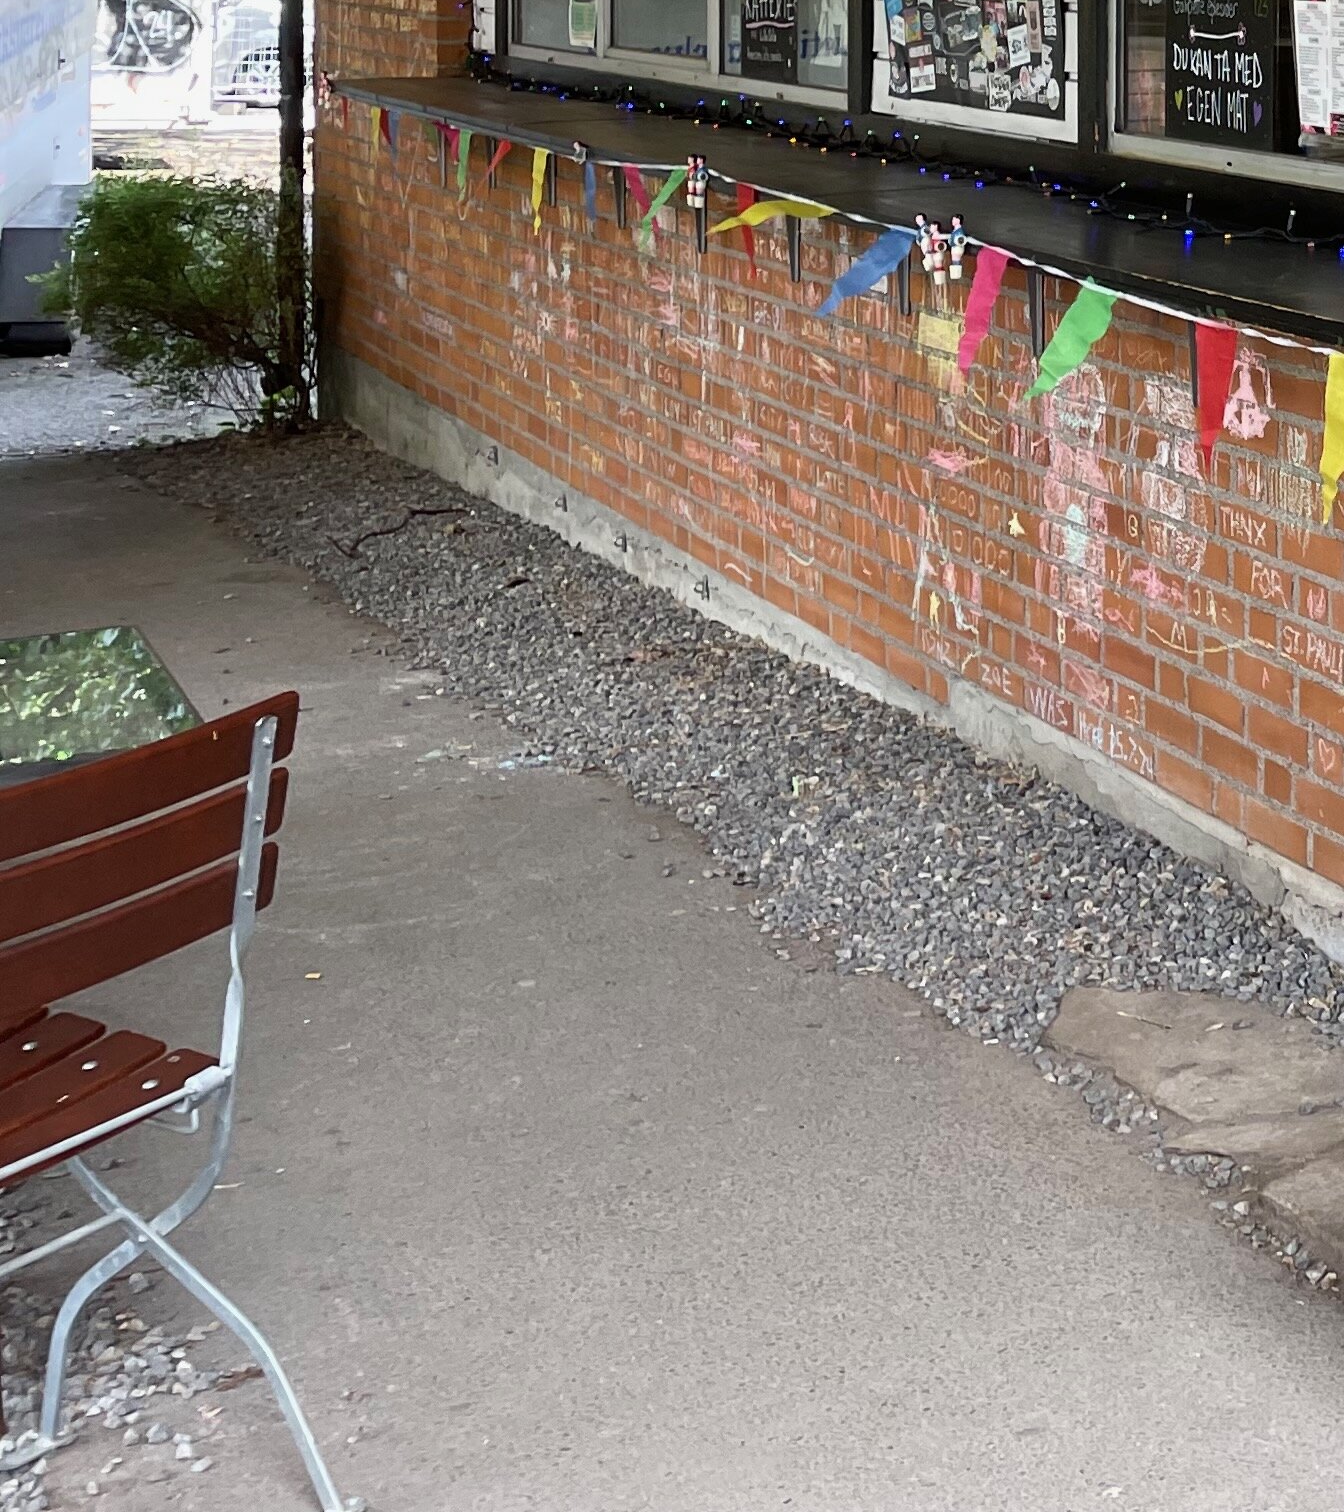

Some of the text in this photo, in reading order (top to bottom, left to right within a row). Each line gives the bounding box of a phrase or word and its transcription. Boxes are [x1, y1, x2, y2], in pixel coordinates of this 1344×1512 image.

[1172, 41, 1264, 89] DU KAN TA MED
[1186, 85, 1250, 133] EGEN MAT
